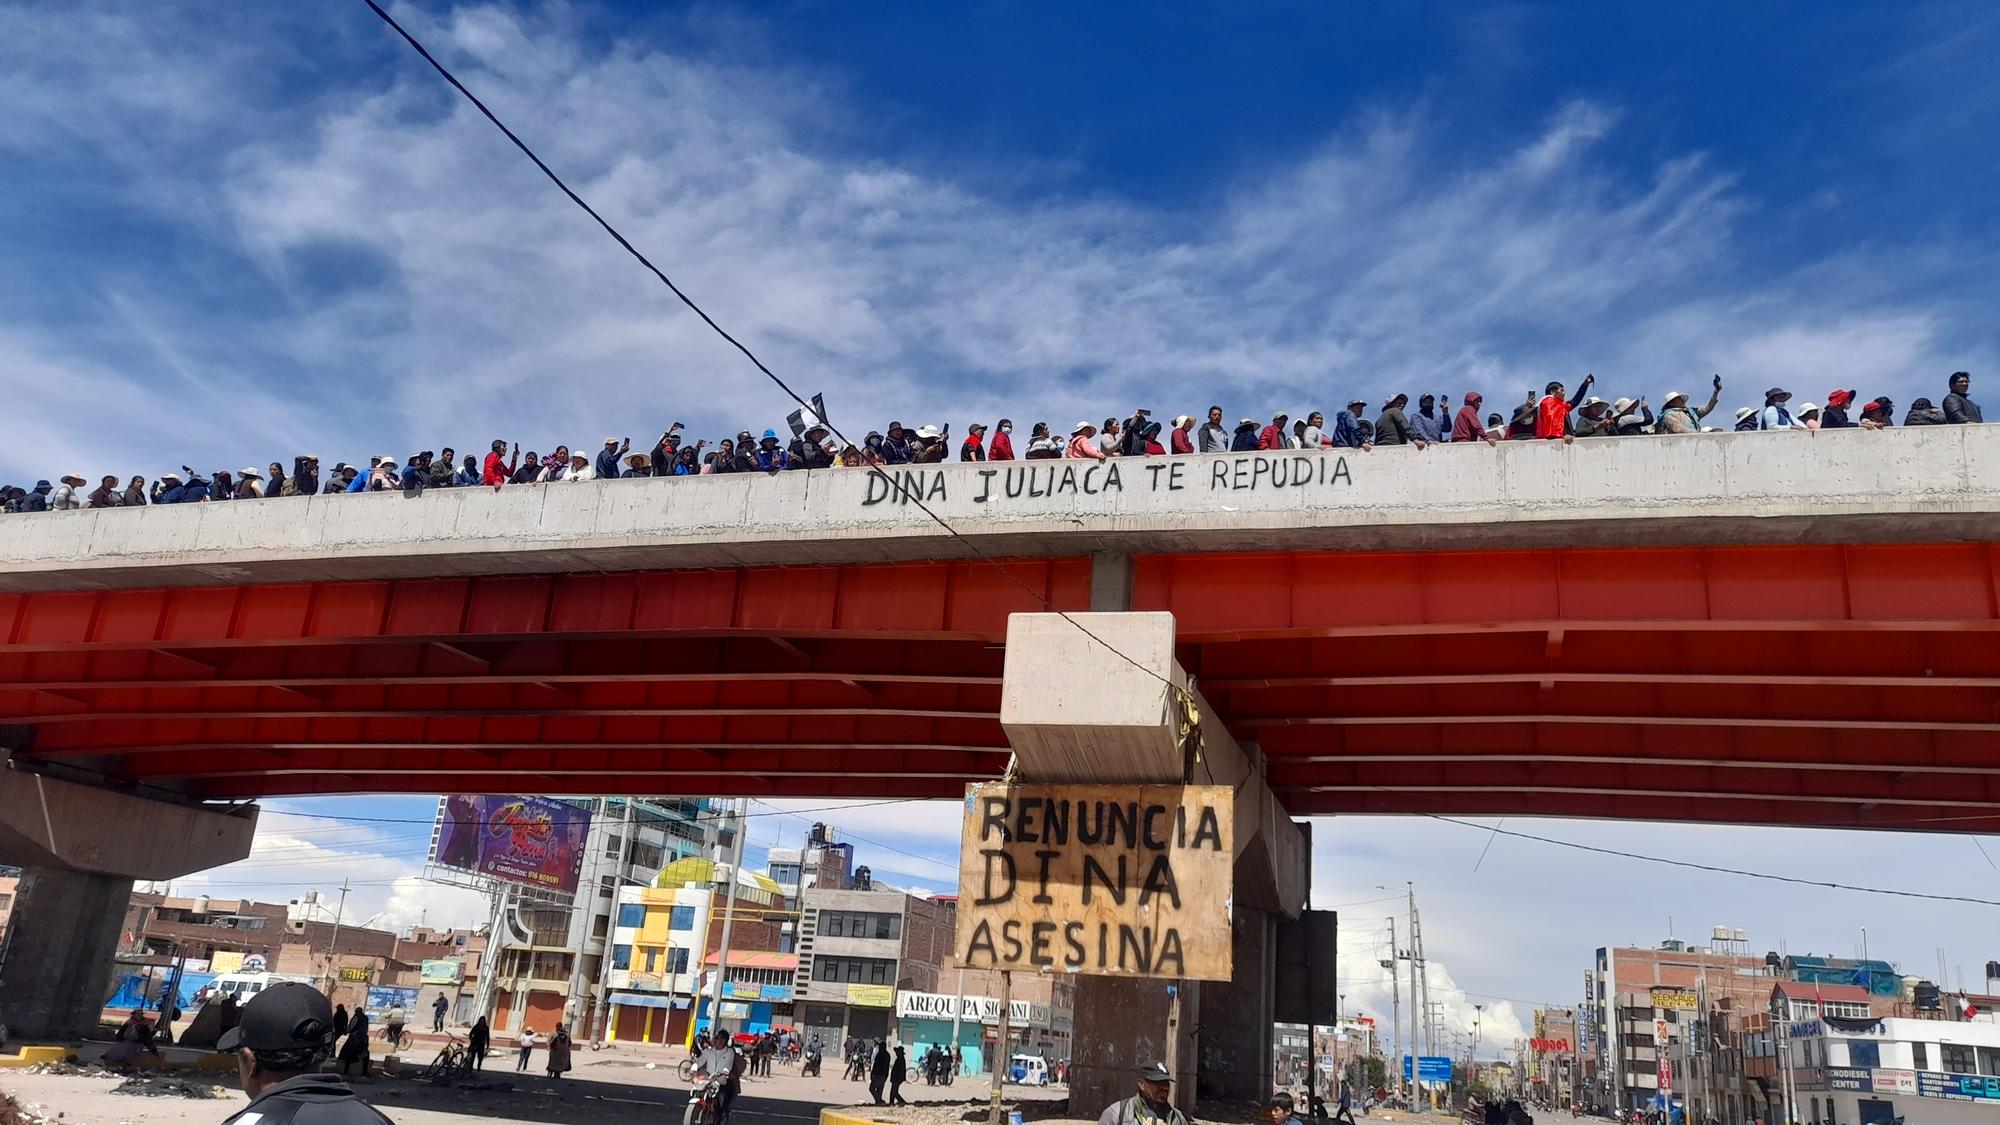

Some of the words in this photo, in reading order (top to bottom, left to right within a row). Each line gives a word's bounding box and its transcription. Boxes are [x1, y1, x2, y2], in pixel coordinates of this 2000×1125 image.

[862, 470, 946, 505] DINA
[974, 462, 1122, 503] JULIACA
[1146, 462, 1185, 491] TE
[1211, 456, 1352, 490] REPUDIA
[980, 796, 1222, 851] RENUNCIA
[975, 849, 1181, 909] DINA
[965, 918, 1184, 975] ASESINA
[906, 995, 980, 1016] AREQUPA
[1831, 1080, 1860, 1089] CENTER
